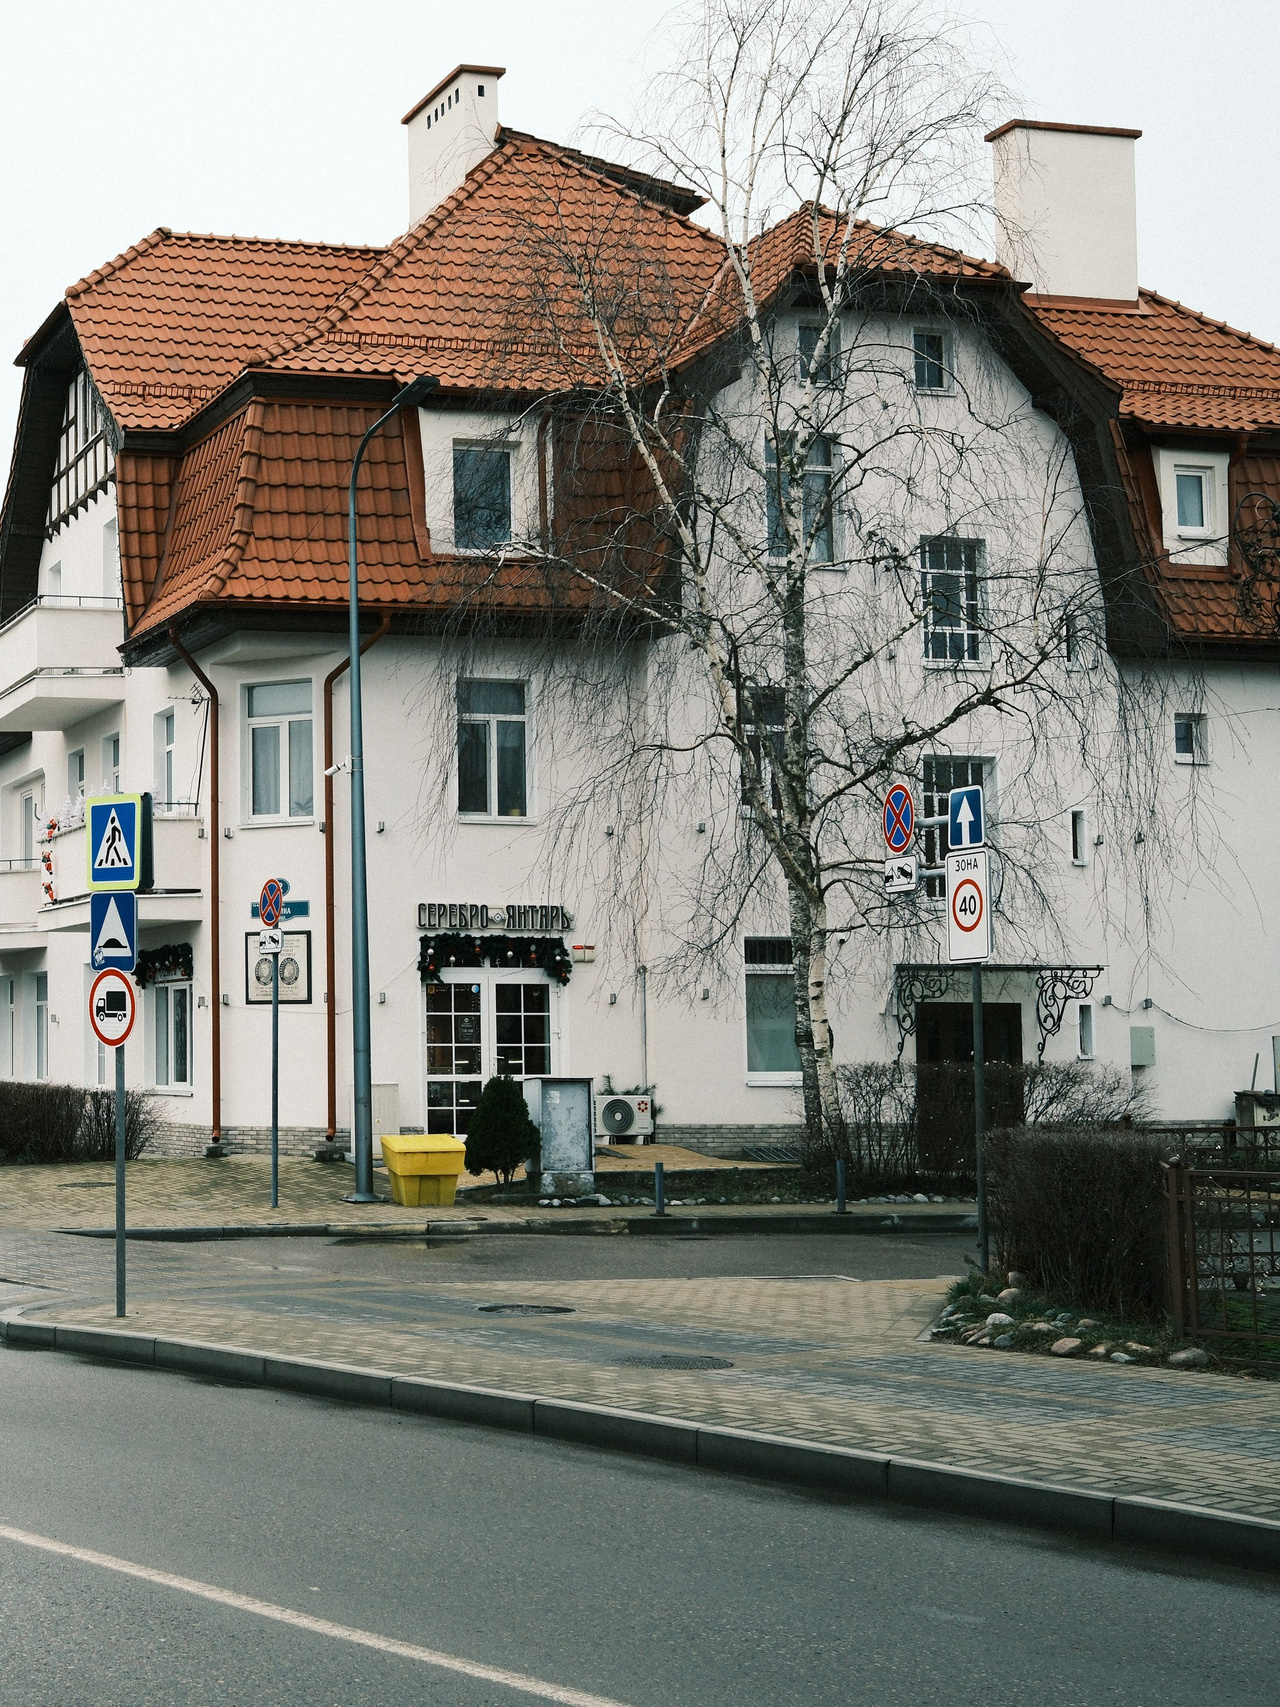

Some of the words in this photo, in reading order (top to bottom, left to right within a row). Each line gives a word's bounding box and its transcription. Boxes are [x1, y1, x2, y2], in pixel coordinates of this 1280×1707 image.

[955, 857, 979, 872] ЗОНА
[959, 894, 977, 916] 40
[417, 903, 489, 929] СЕРЕБРО
[505, 904, 572, 930] ЯНТАРЬ
